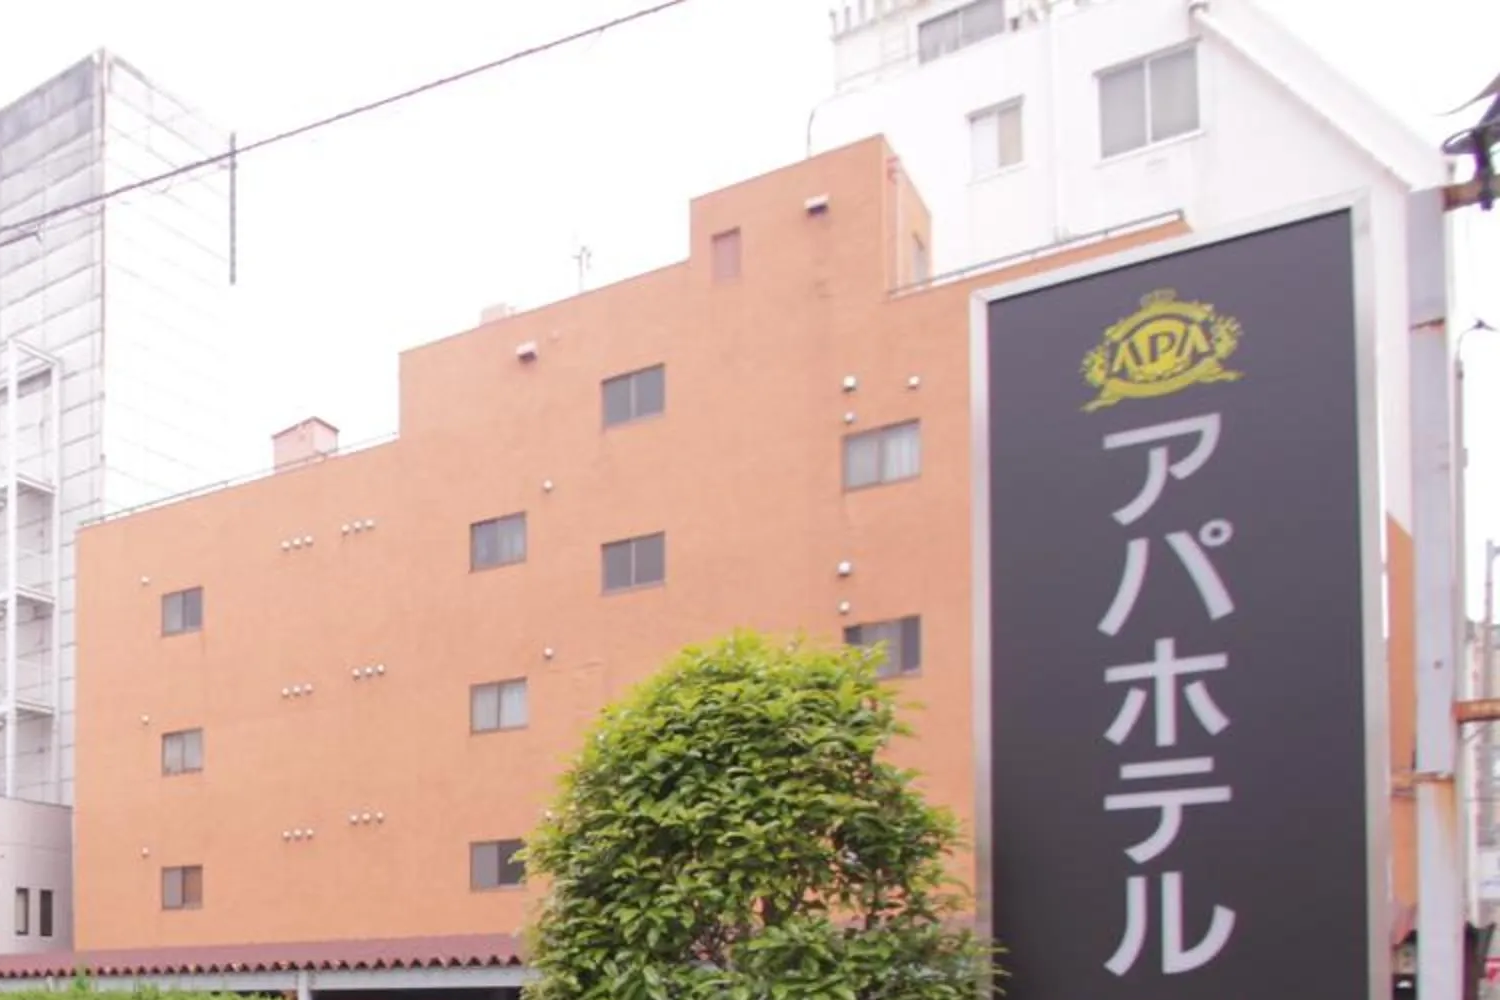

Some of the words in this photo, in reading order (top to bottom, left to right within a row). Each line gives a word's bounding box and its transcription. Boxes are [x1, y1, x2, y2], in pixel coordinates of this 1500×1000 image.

[1097, 412, 1237, 977] アパホテル
